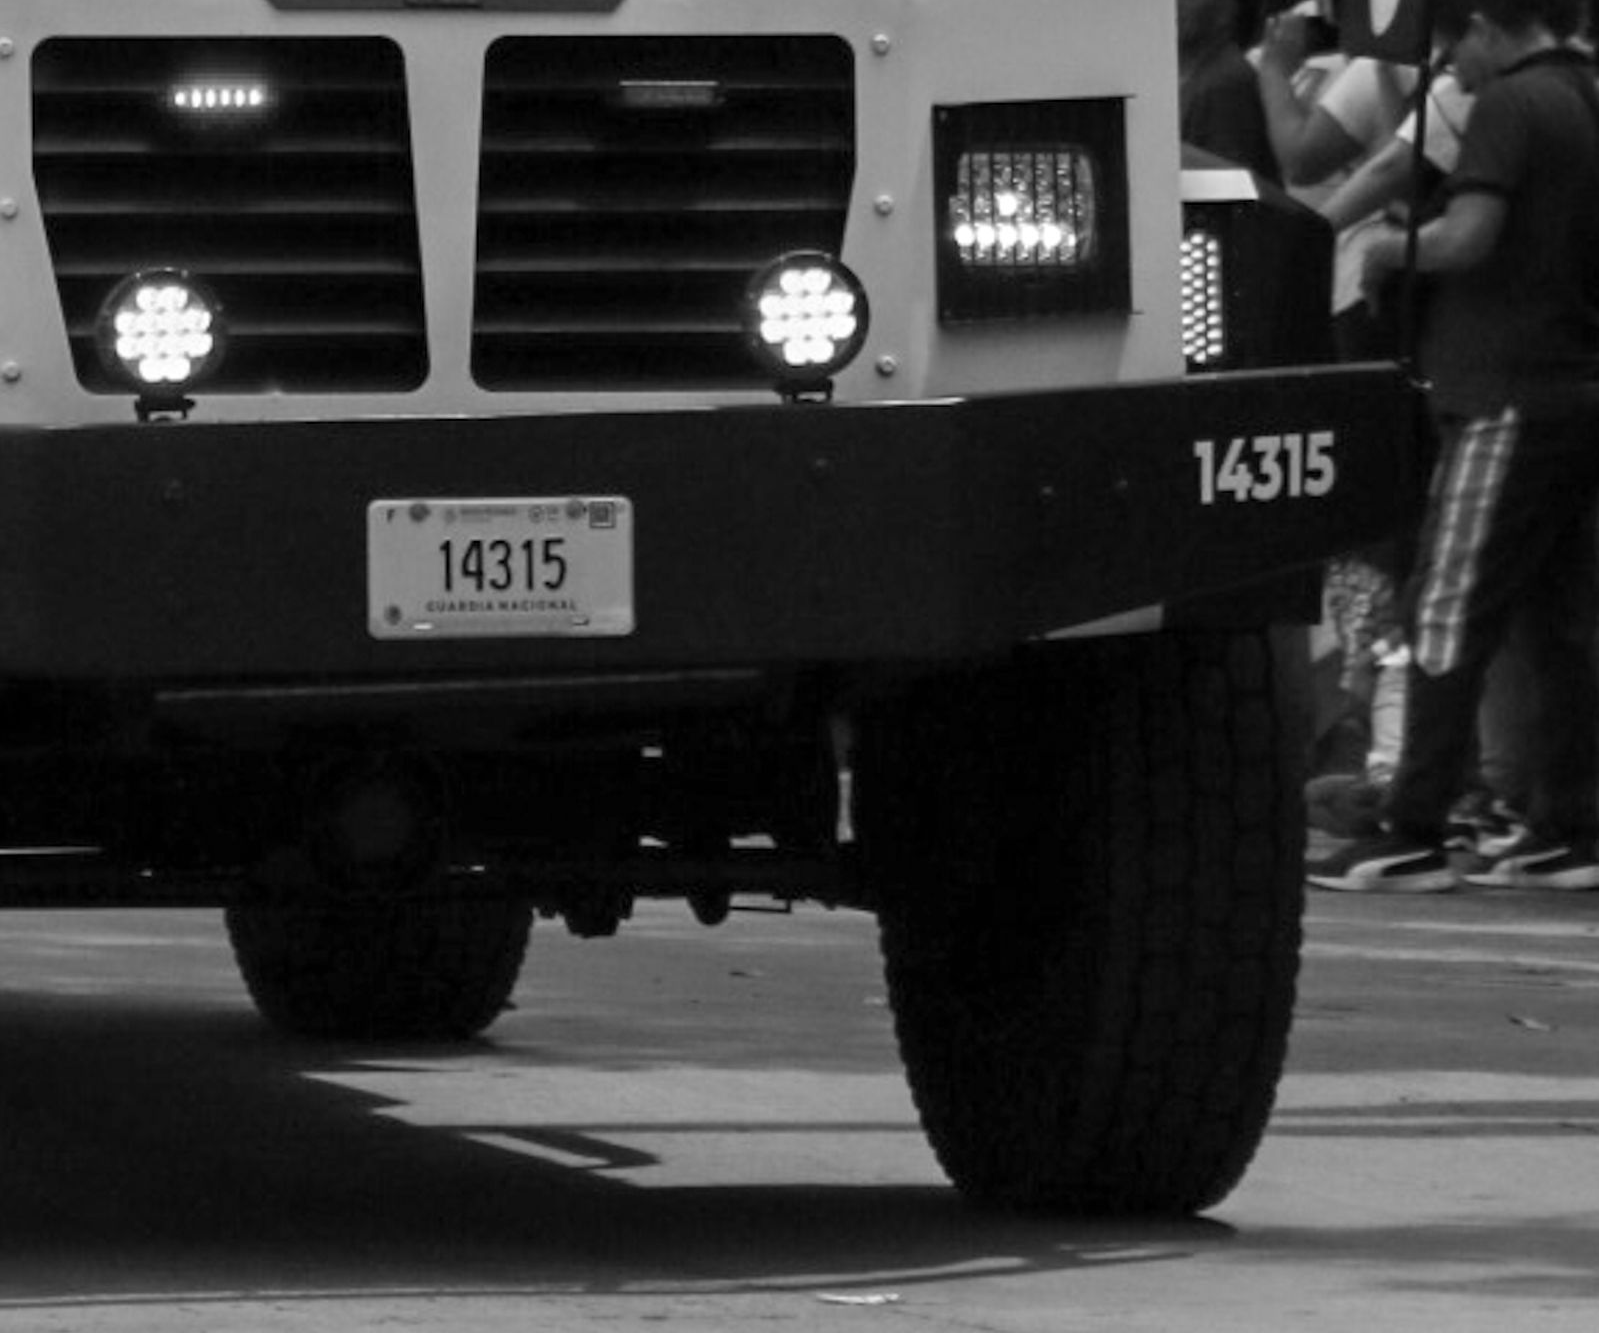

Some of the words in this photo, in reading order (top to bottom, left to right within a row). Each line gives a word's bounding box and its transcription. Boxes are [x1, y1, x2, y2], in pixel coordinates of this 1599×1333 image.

[1193, 430, 1336, 505] 14315
[439, 537, 568, 592] 14315
[425, 599, 494, 613] GUARDIA
